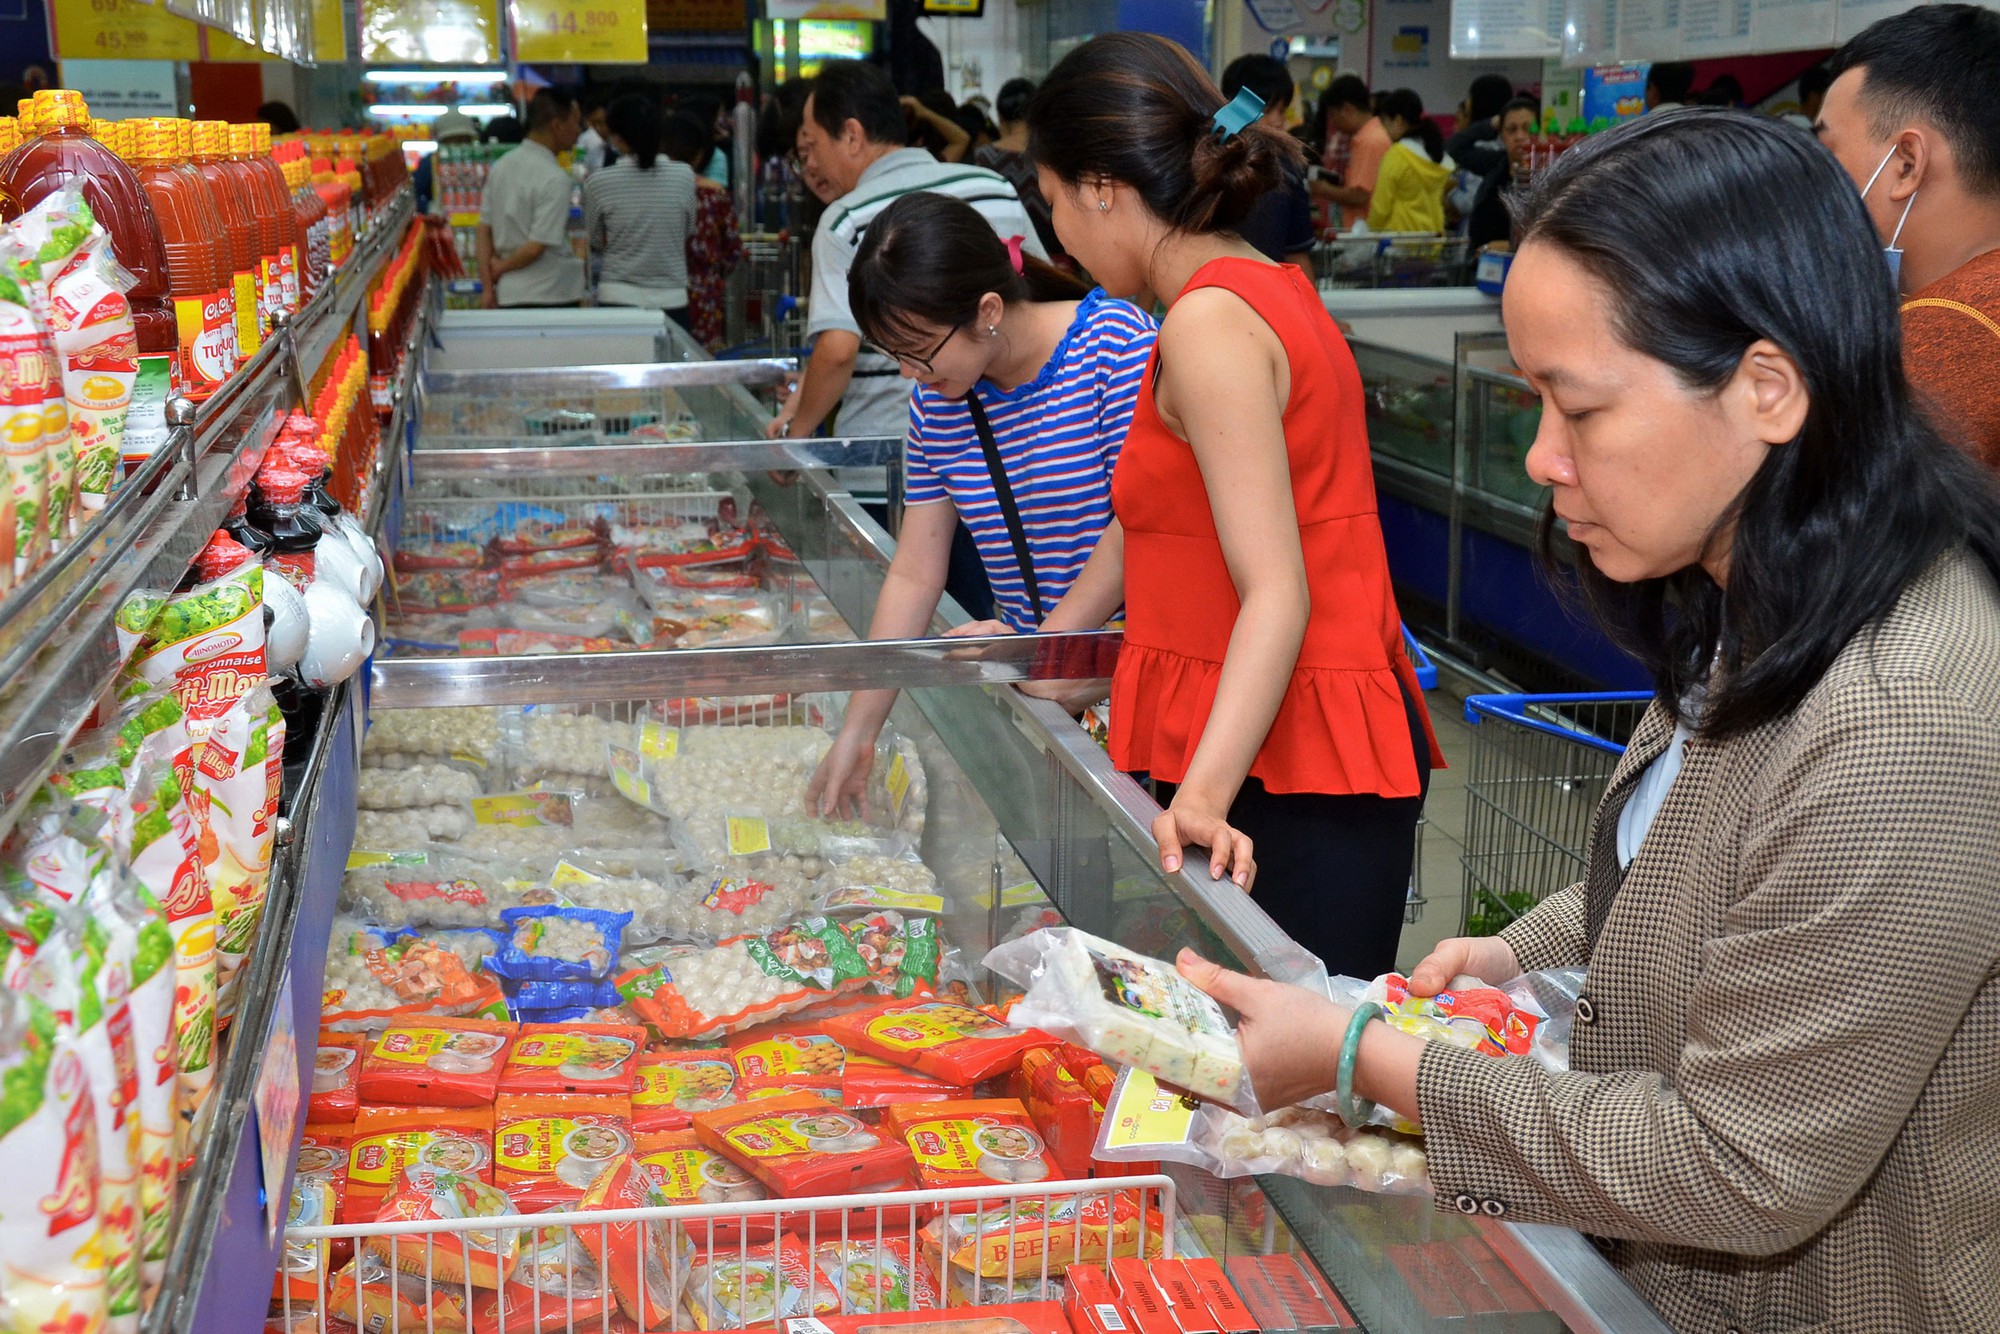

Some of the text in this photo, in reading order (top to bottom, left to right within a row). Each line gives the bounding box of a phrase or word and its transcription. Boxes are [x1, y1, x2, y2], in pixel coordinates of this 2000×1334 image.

[189, 637, 237, 658] AJINOMOTO
[183, 654, 262, 676] Mayonnaise
[992, 1235, 1061, 1262] BEEF
[1133, 1280, 1158, 1314] MAYUMI
[1171, 1280, 1196, 1311] MAYUMI
[1207, 1279, 1235, 1311] MAYUMI
